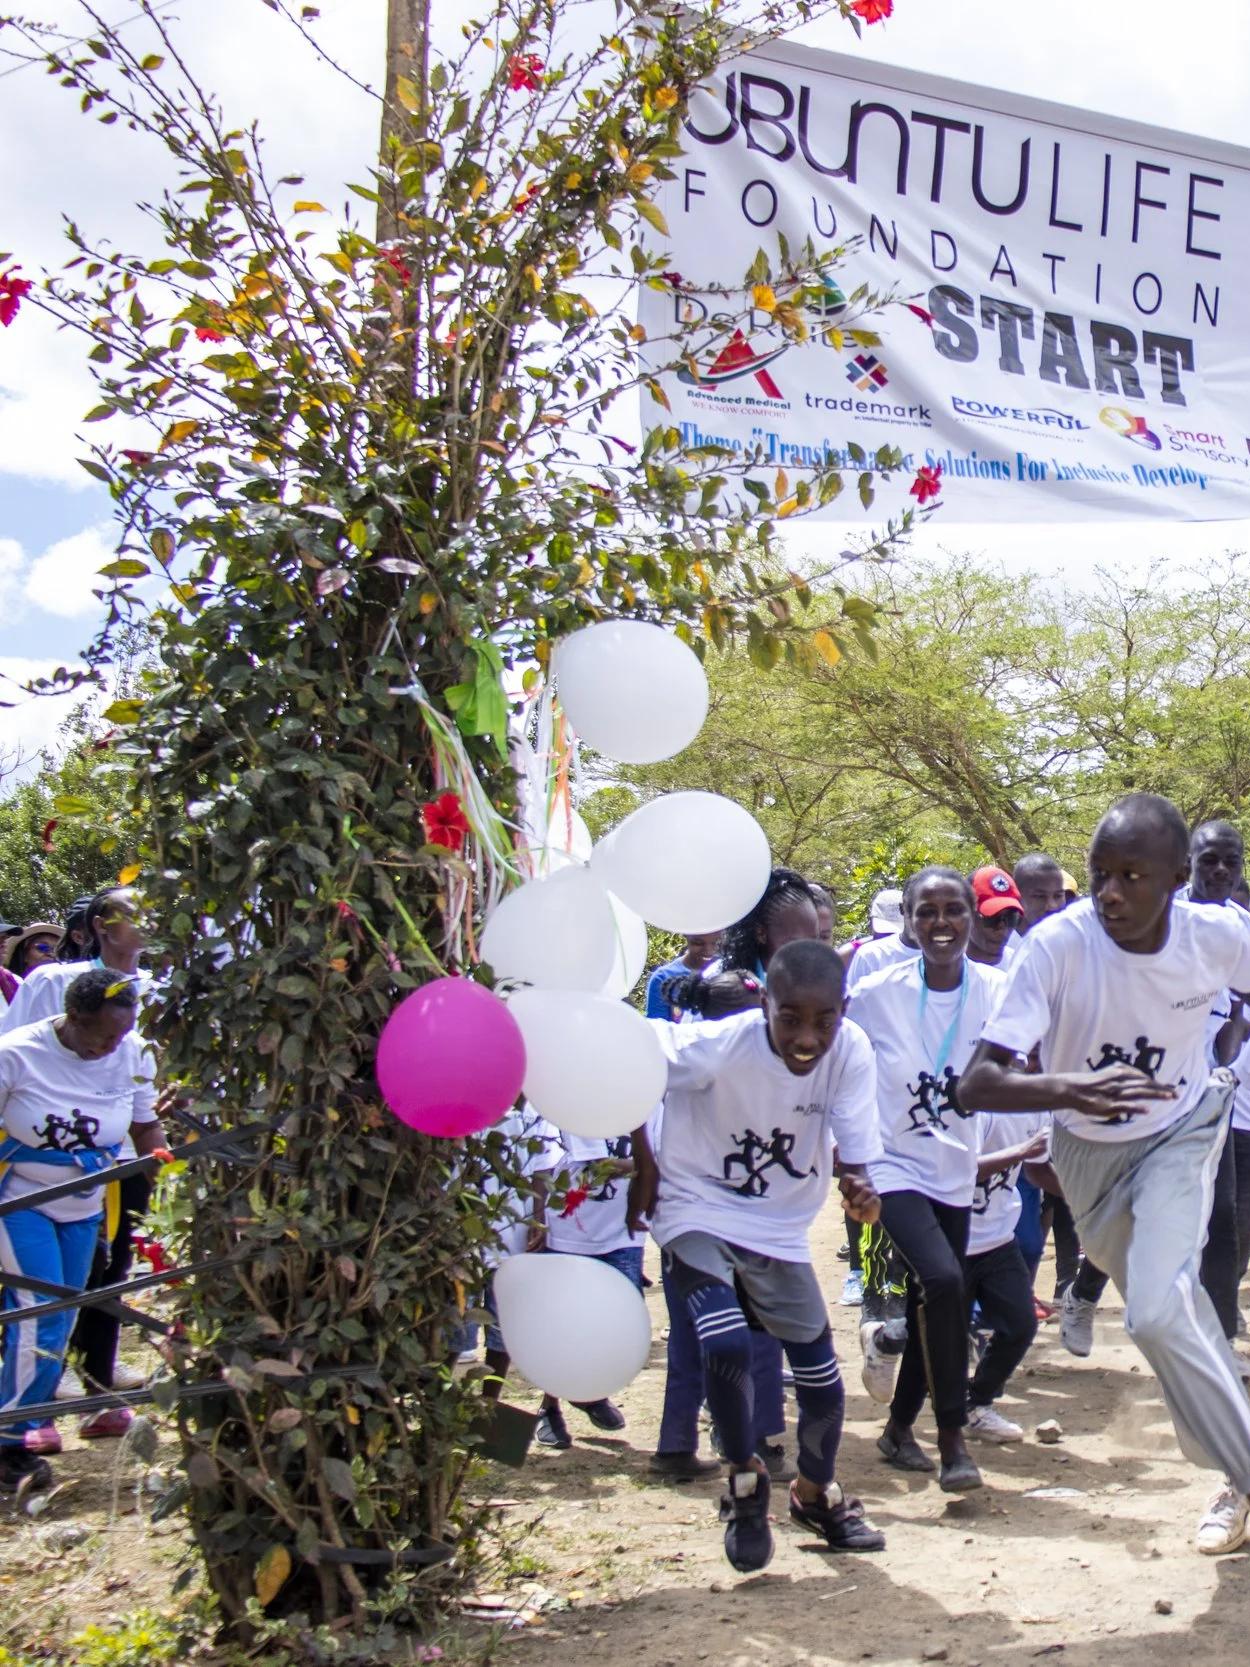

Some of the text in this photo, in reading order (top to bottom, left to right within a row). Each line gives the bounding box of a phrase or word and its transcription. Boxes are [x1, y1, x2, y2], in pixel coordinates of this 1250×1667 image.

[684, 168, 1221, 327] FOUNDATION
[928, 284, 1195, 408] START
[687, 389, 792, 410] Advanced Medical
[708, 403, 738, 415] KNOW
[740, 407, 787, 419] COMFORT
[805, 392, 932, 421] trademark
[951, 396, 1091, 431] POWERFUL
[925, 447, 1011, 481] Solutions
[1016, 452, 1050, 482] For
[1053, 457, 1131, 484] Inclusive
